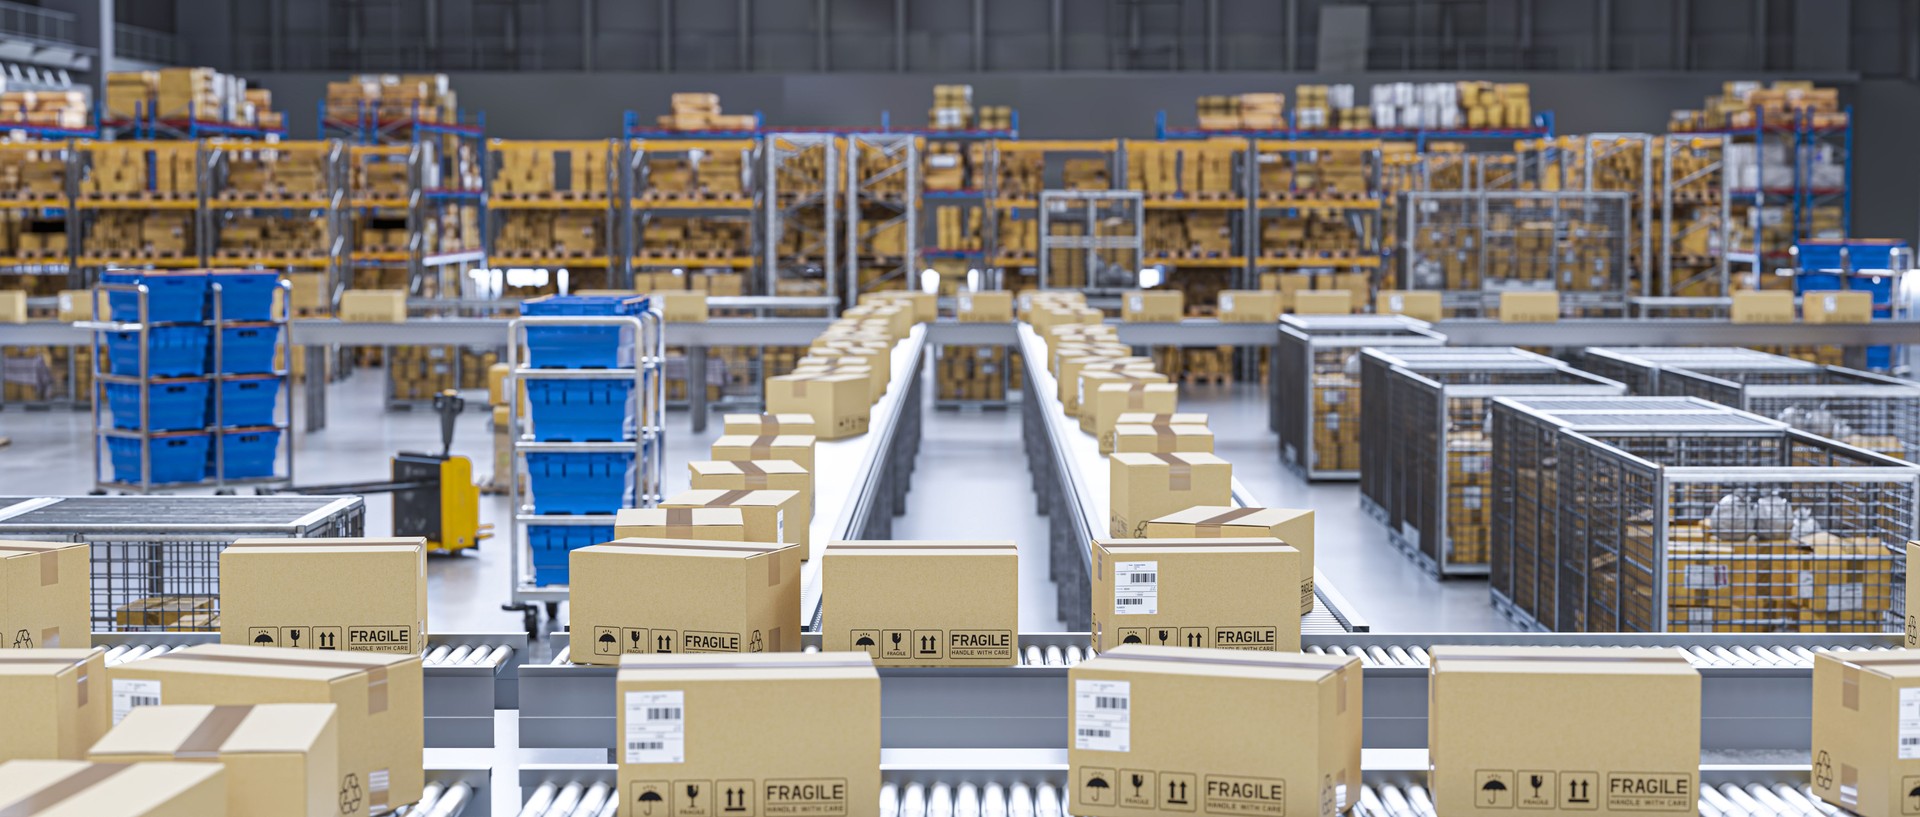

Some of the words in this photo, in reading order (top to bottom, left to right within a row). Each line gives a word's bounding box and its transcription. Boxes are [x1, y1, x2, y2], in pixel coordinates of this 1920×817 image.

[350, 630, 409, 642] FRAGILE
[685, 635, 739, 650] FRAGILE
[951, 634, 1010, 646] FRAGILE
[1217, 630, 1275, 643] FRAGILE
[766, 784, 844, 800] FRAGILE
[1207, 781, 1282, 801] FRAGILE
[1610, 778, 1688, 795] FRAGILE
